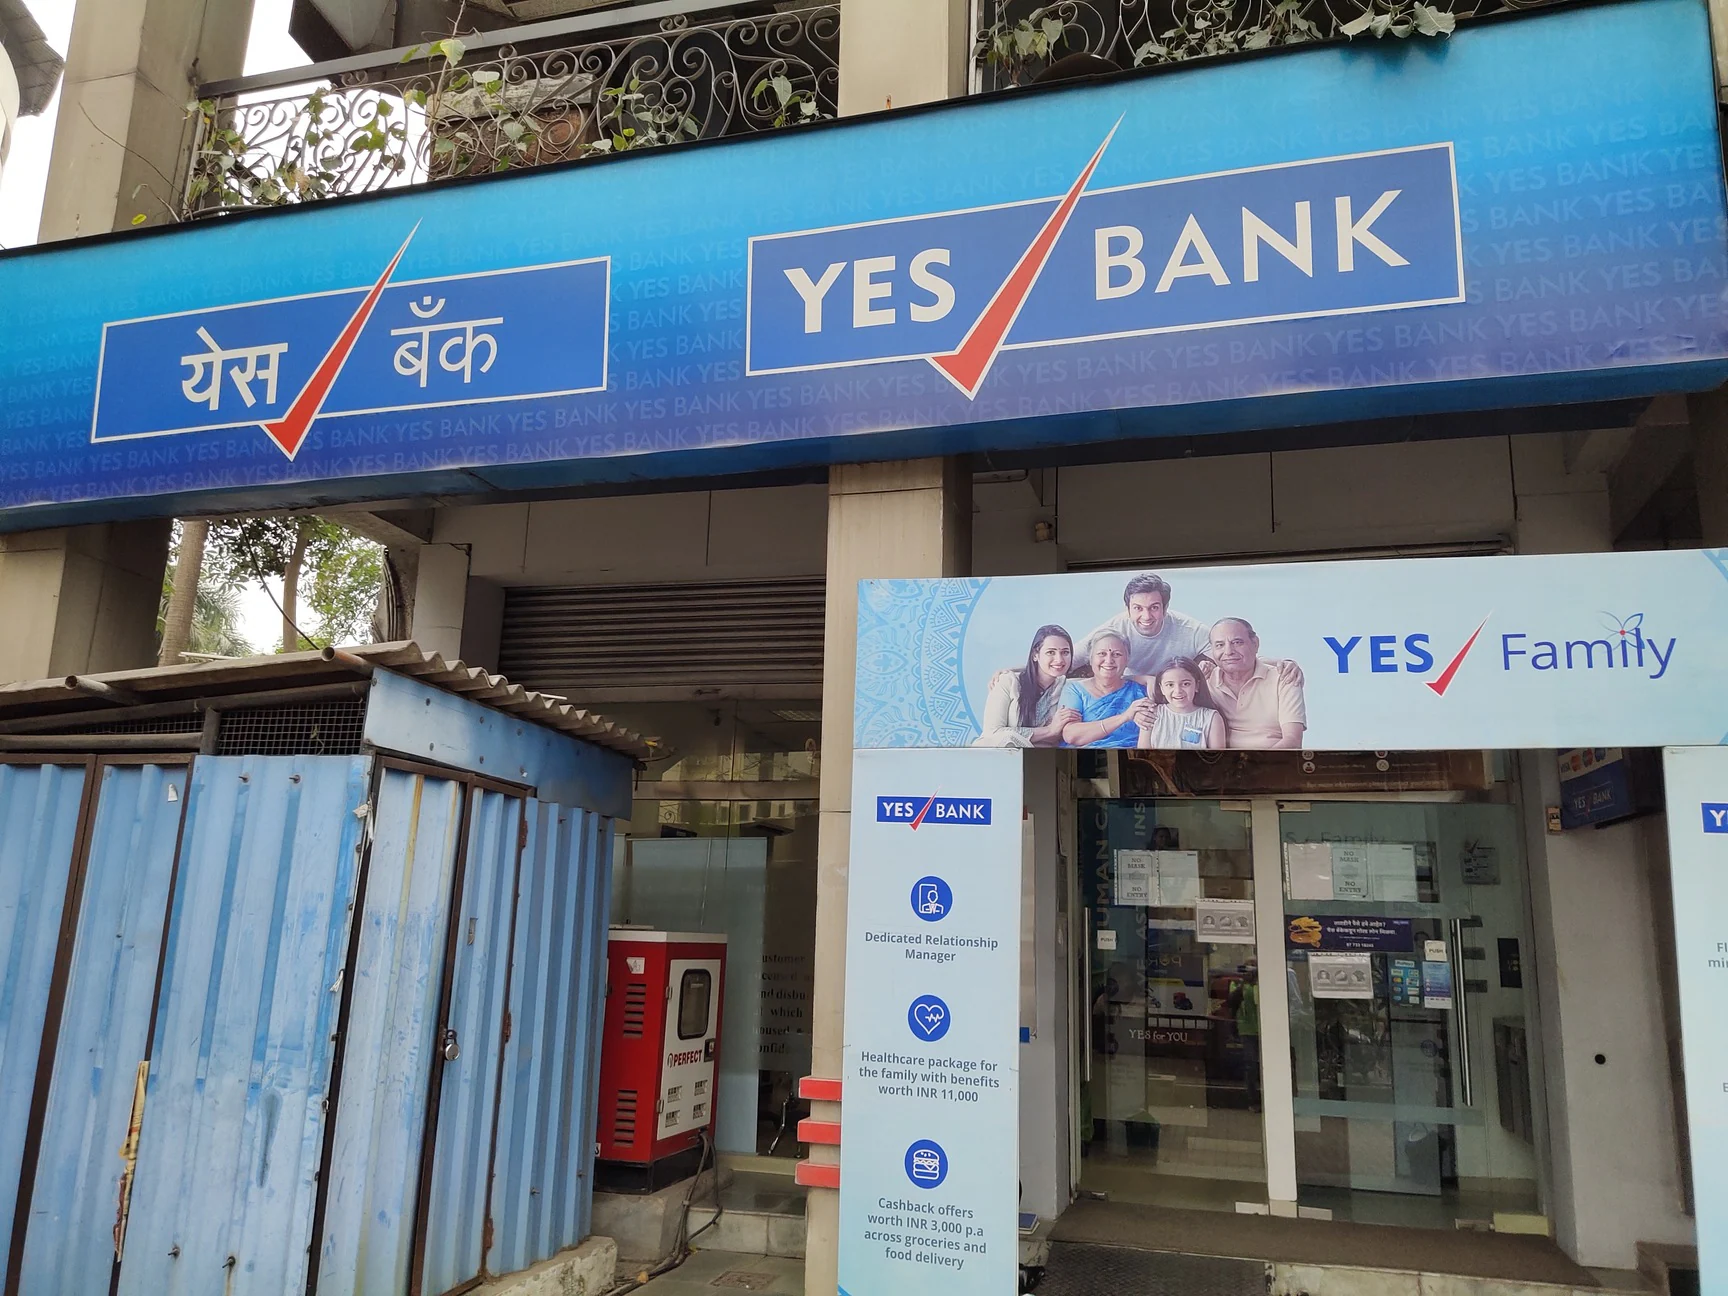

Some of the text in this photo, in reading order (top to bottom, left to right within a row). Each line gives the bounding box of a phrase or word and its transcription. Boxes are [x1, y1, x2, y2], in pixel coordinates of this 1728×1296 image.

[783, 189, 1411, 333] YES BANK
[180, 326, 289, 411] येस
[1322, 627, 1677, 680] YES Family
[883, 802, 985, 819] YES BANK
[865, 932, 998, 951] Dedicated Relationship
[905, 949, 956, 963] Manager
[1128, 1028, 1188, 1042] YES for YOU
[673, 1050, 702, 1067] PERFECT
[861, 1051, 998, 1072] Healthcare package for
[859, 1067, 1000, 1088] the family with benefits
[878, 1084, 979, 1102] worth INR 11,000
[878, 1197, 974, 1219] Cashback offers
[867, 1214, 984, 1238] worth INR 3,000 p.a
[864, 1229, 987, 1254] across groceries and
[885, 1247, 965, 1271] food delivery
